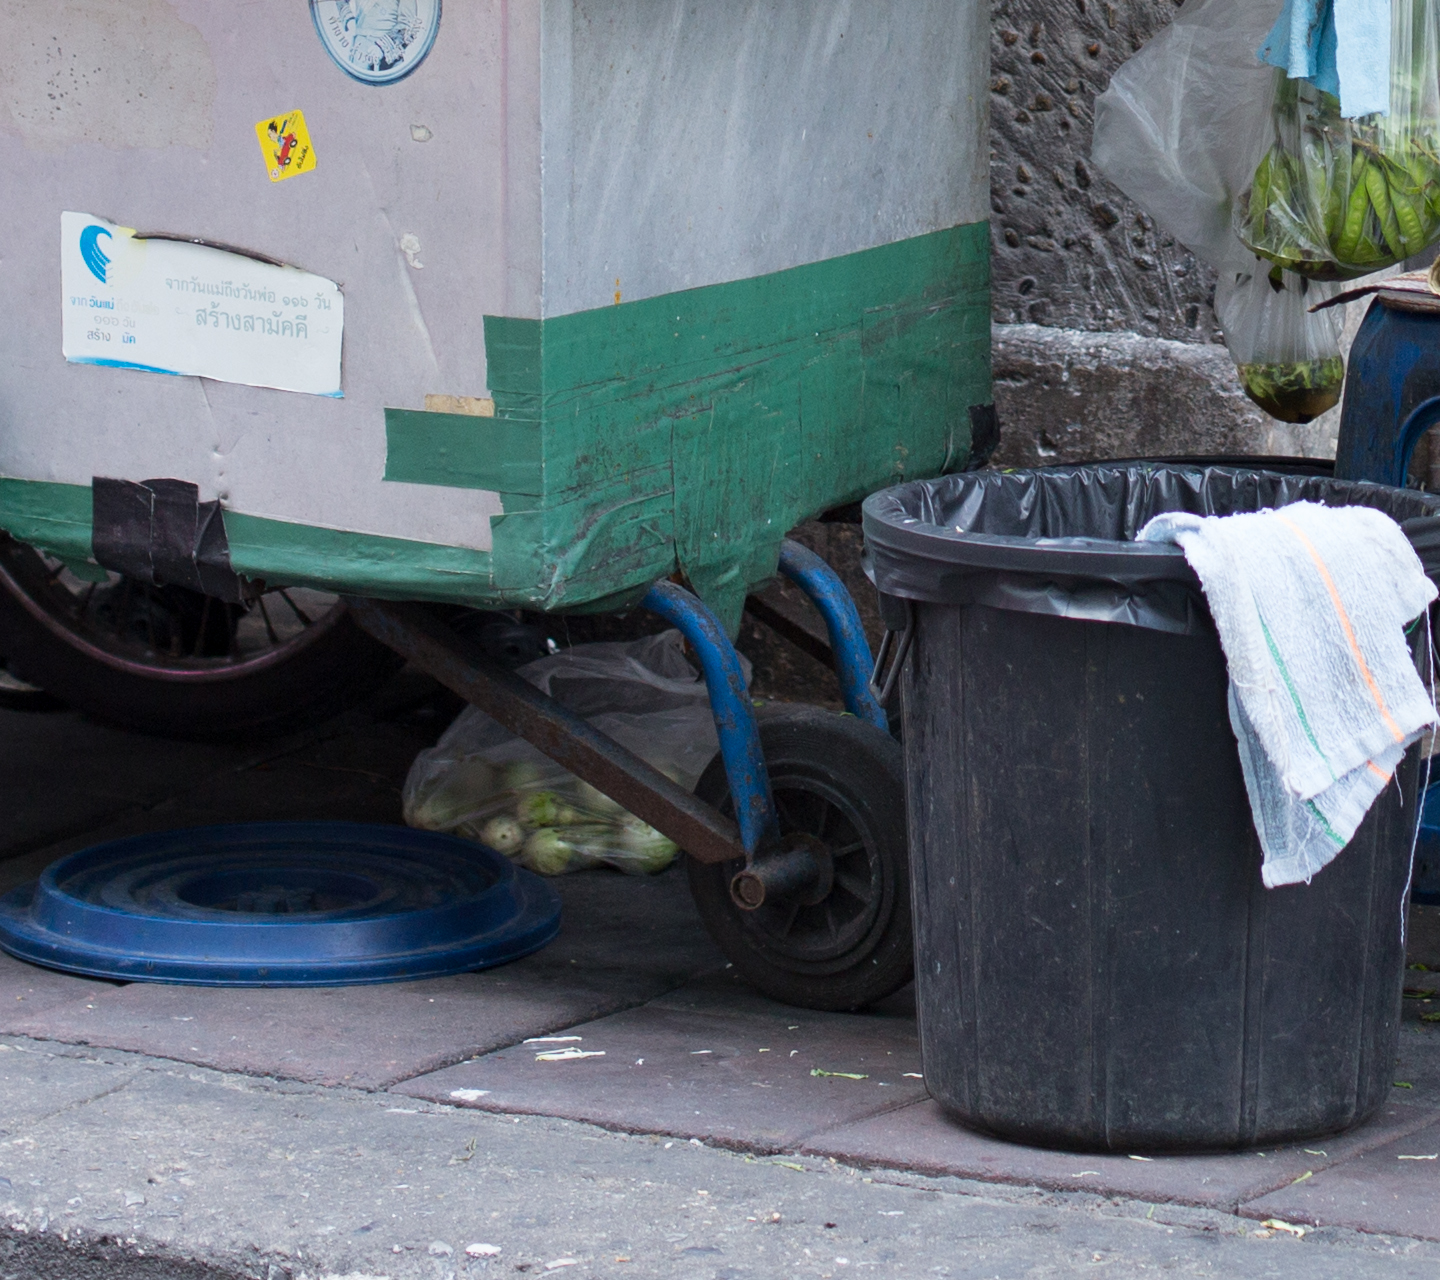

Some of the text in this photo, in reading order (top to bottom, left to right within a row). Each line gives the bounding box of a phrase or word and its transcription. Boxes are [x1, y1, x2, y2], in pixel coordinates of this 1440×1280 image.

[165, 276, 276, 303] จากวันแม่ถึงวันพ่อ
[314, 292, 331, 310] วัน
[87, 329, 111, 342] สร้าง
[196, 303, 308, 339] สร้างสามัคคี
